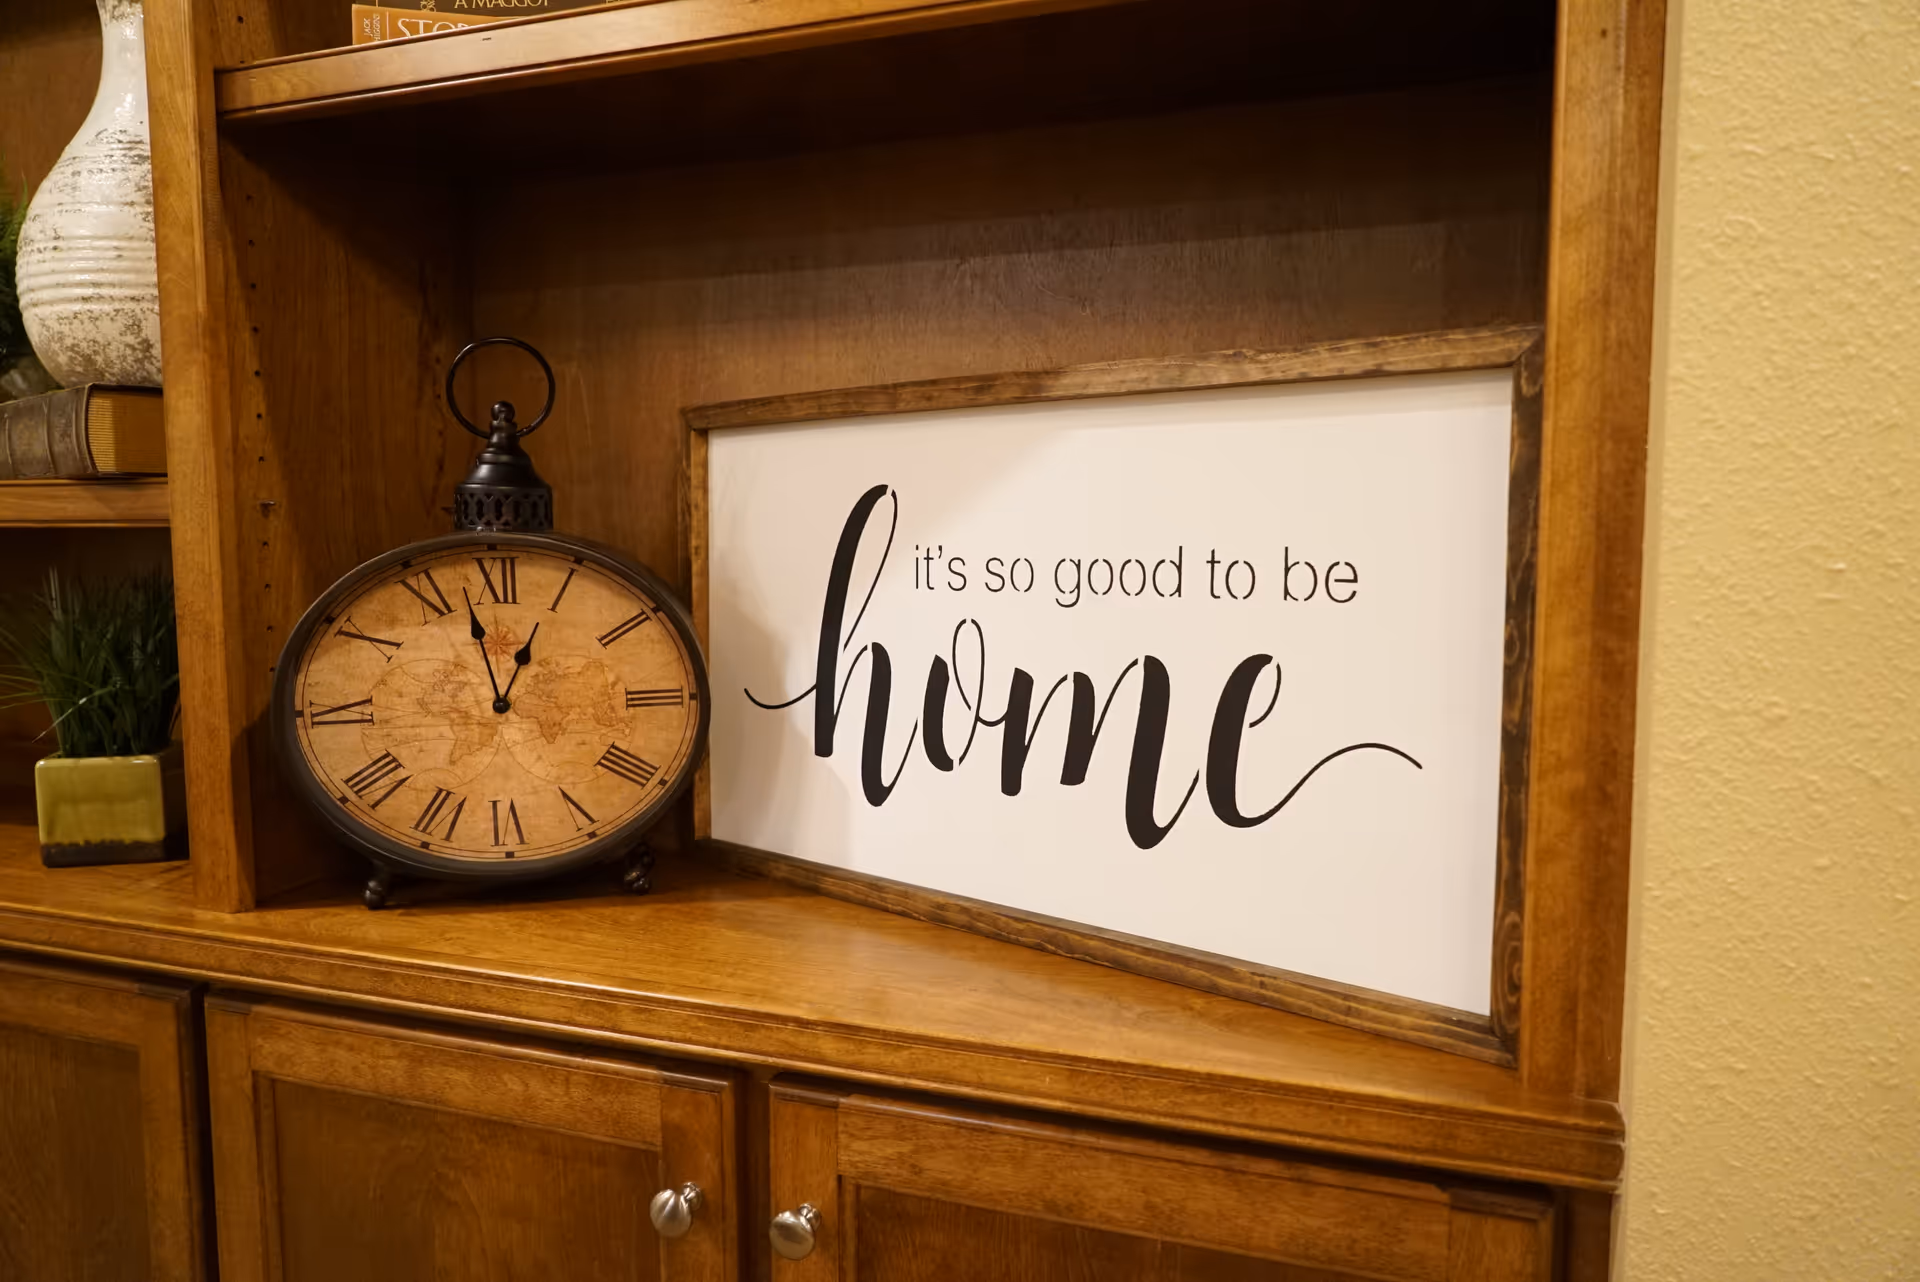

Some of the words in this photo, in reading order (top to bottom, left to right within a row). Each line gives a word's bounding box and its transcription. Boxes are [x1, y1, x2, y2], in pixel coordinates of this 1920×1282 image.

[363, 17, 373, 37] JACK
[394, 566, 457, 626] XI
[471, 556, 521, 605] XII
[914, 545, 968, 593] it's
[985, 556, 1035, 593] so
[1053, 545, 1184, 609] good
[1206, 548, 1257, 600] to
[1284, 545, 1360, 604] be
[334, 616, 405, 663] X
[597, 607, 653, 650] II
[743, 483, 1424, 851] home
[625, 686, 684, 711] III
